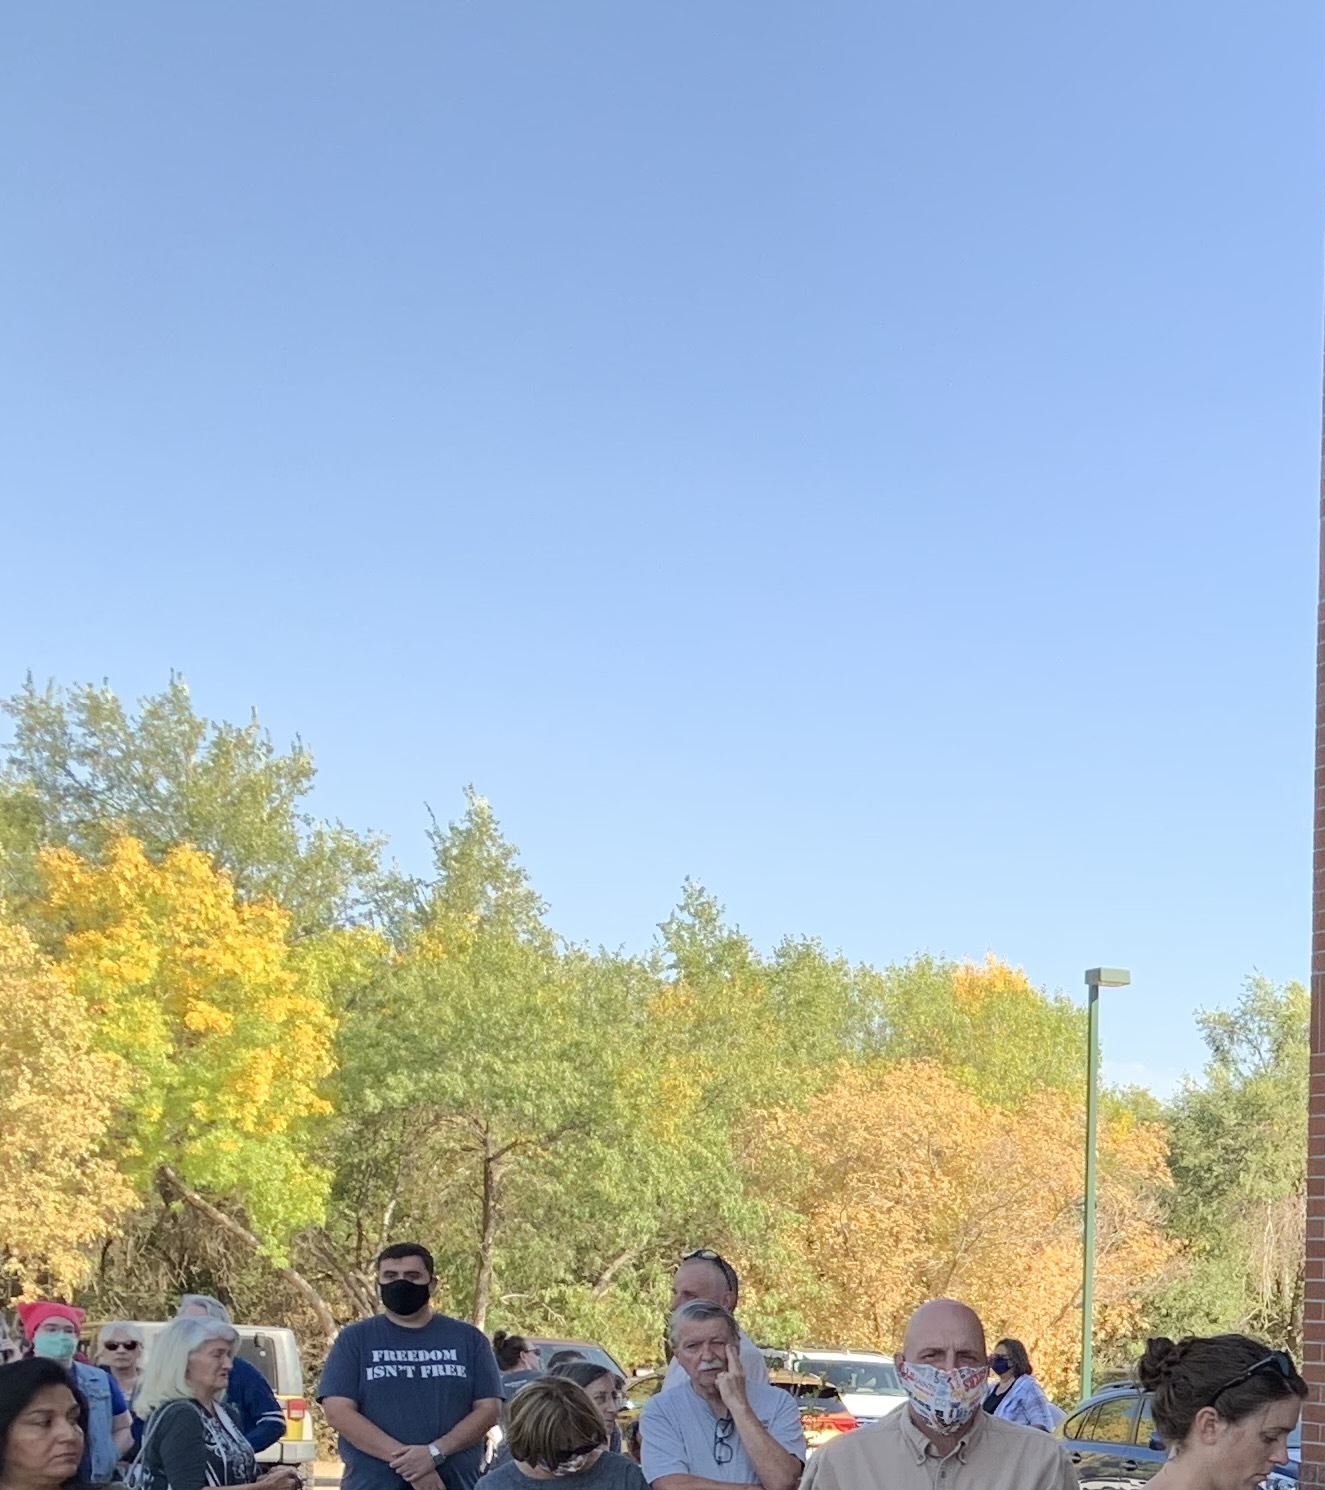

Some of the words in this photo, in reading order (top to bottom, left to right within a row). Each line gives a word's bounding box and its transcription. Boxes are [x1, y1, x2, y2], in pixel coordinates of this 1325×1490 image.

[372, 1349, 457, 1362] FREEDOM
[366, 1364, 415, 1380] ISN'T
[420, 1364, 466, 1378] FREE
